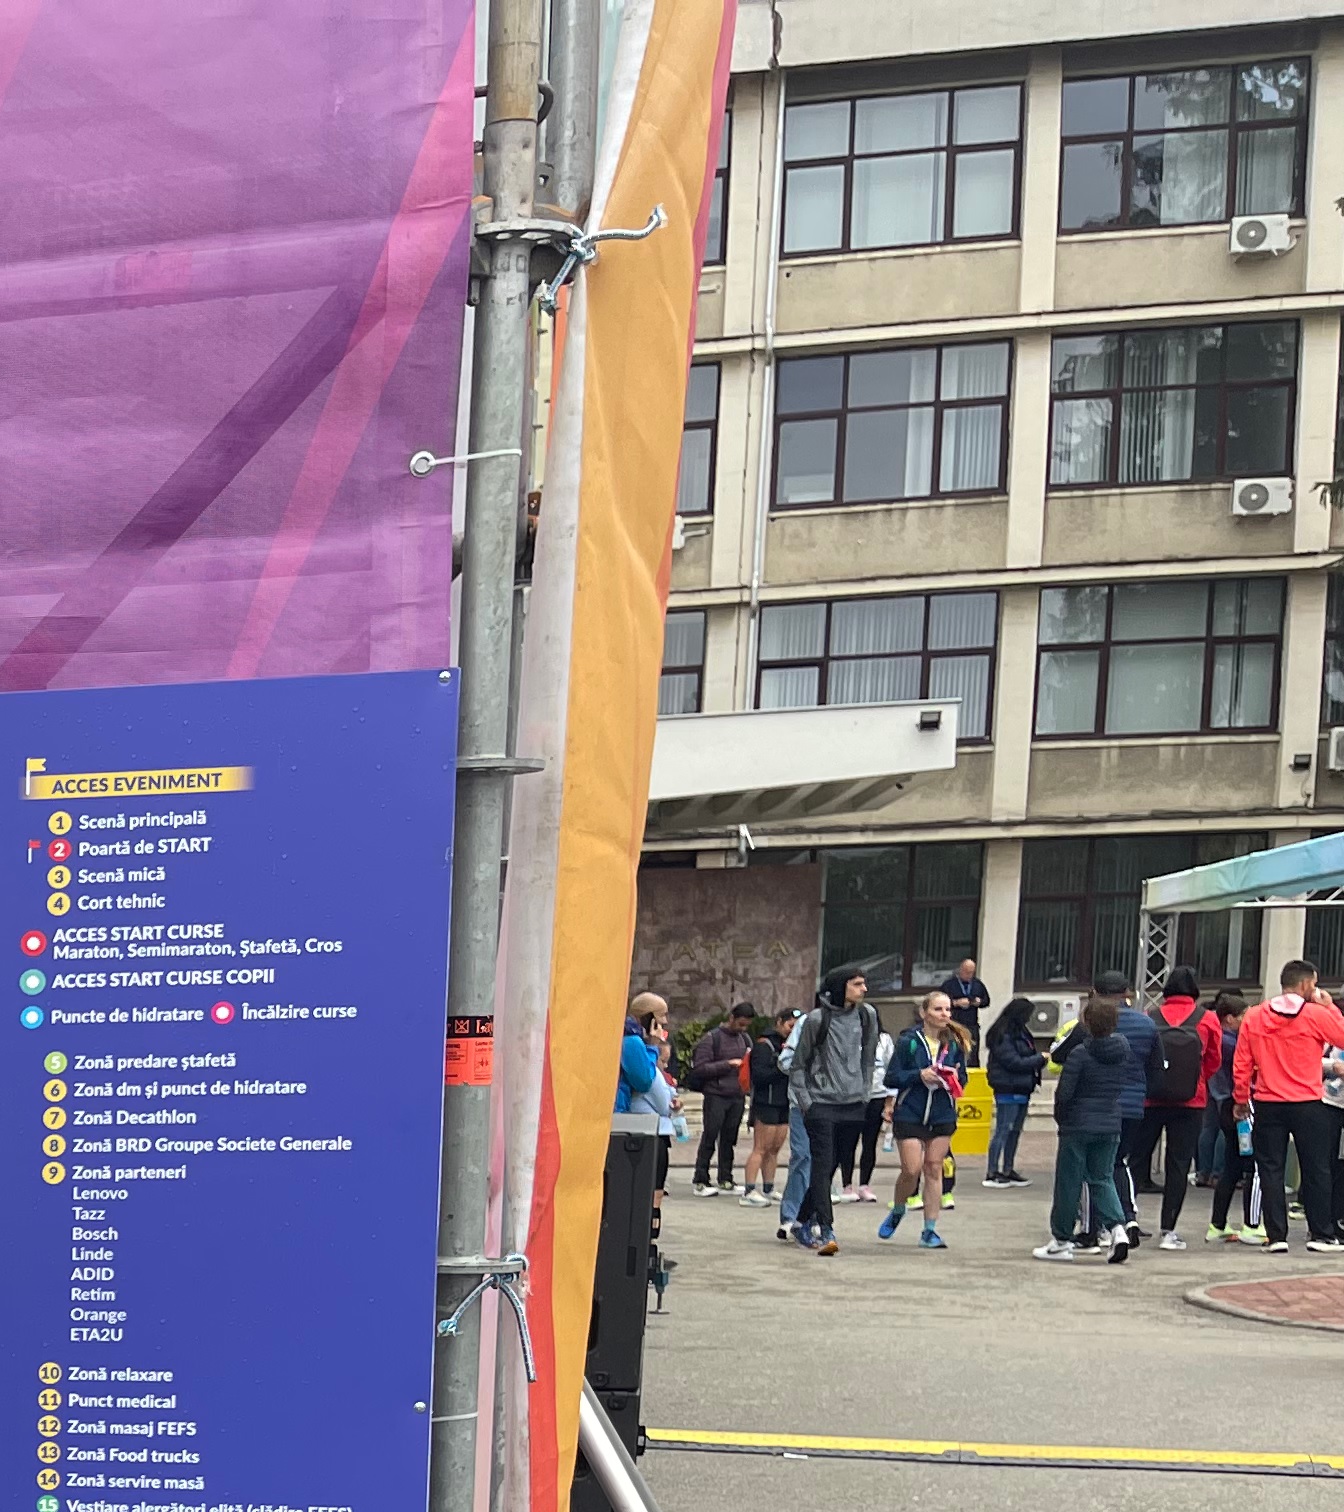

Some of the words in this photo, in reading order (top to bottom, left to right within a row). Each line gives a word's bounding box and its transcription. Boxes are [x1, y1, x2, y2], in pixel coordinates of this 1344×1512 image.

[51, 779, 109, 795] ACCES
[113, 773, 223, 791] EVENIMENT
[55, 817, 64, 829] 1
[79, 813, 126, 830] Scenă
[129, 810, 207, 829] principală
[54, 843, 65, 857] 2
[78, 841, 130, 857] Poartă
[134, 839, 154, 854] de
[158, 838, 212, 853] START
[53, 927, 107, 943] ACCES
[111, 926, 164, 942] START
[167, 924, 224, 940] CURSE
[53, 945, 124, 962] Maraton,
[127, 942, 236, 959] Semimaraton,
[240, 939, 301, 957] Ștafetă,
[305, 938, 342, 954] Cros
[51, 1010, 106, 1024] Puncte
[109, 1009, 129, 1023] de
[132, 1007, 204, 1023] hidratare
[242, 1002, 310, 1021] Încălzire
[313, 1006, 357, 1019] curse
[50, 1112, 60, 1125] 7
[73, 1109, 112, 1125] Zonă
[116, 1110, 196, 1125] Decathlon
[49, 1167, 58, 1179] 9
[72, 1164, 111, 1180] Zonă
[115, 1165, 186, 1181] parteneri
[73, 1187, 128, 1201] Lenovo
[72, 1207, 106, 1221] Tazz
[72, 1227, 119, 1241] Bosch
[71, 1248, 114, 1261] Linde
[70, 1268, 114, 1281] ADID
[70, 1288, 115, 1301] Retim
[70, 1308, 127, 1324] Orange
[70, 1328, 123, 1342] ETA2U
[38, 1499, 58, 1512] 15
